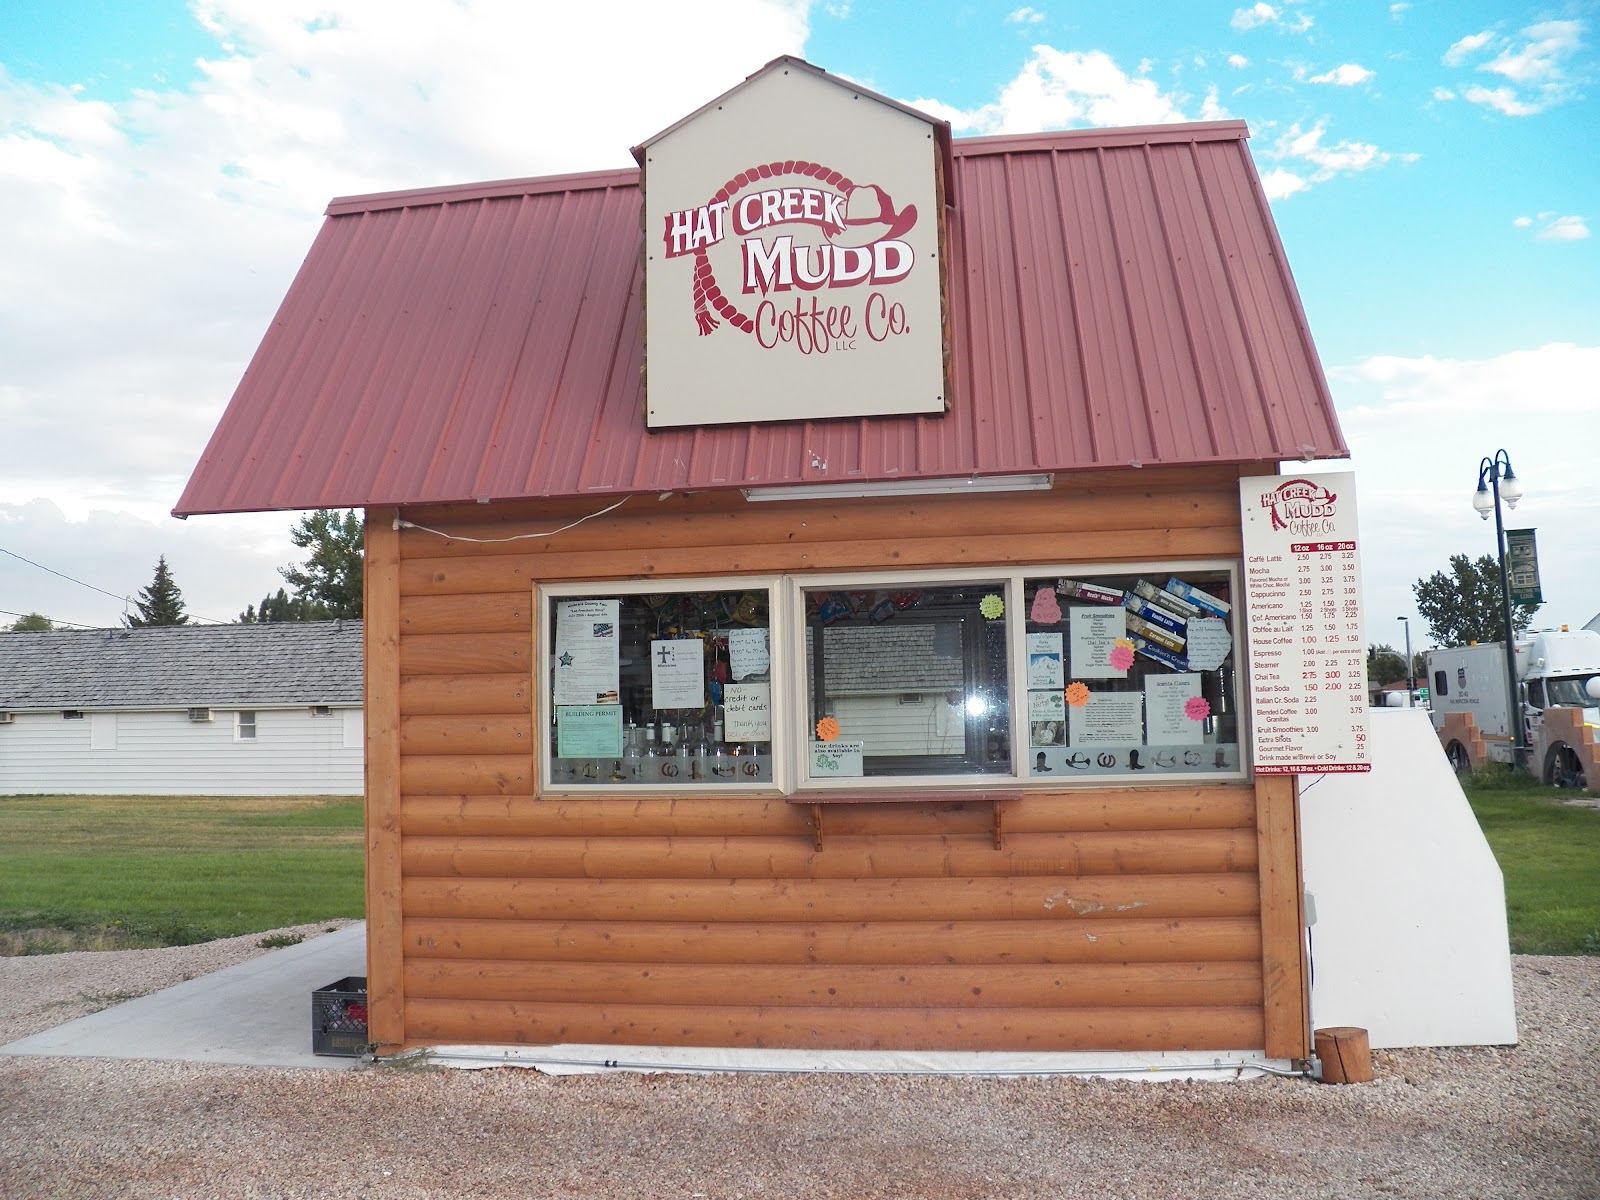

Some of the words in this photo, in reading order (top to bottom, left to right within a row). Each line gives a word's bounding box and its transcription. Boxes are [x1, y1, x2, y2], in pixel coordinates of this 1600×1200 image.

[664, 201, 729, 258] HAT
[733, 188, 848, 235] CREEK
[741, 236, 914, 296] MUDD
[756, 296, 857, 354] Coffee
[865, 293, 910, 342] Co.
[836, 340, 856, 350] LLC
[1261, 491, 1282, 507] HAT
[1282, 487, 1317, 501] CREEK
[1285, 502, 1336, 519] MUDD
[1290, 520, 1320, 537] Coffee
[1322, 519, 1336, 533] Co.
[1151, 612, 1164, 622] Vanilla
[1164, 617, 1174, 627] Latte
[1149, 632, 1165, 642] Caramel
[1164, 638, 1174, 648] Latte
[726, 704, 745, 712] debit
